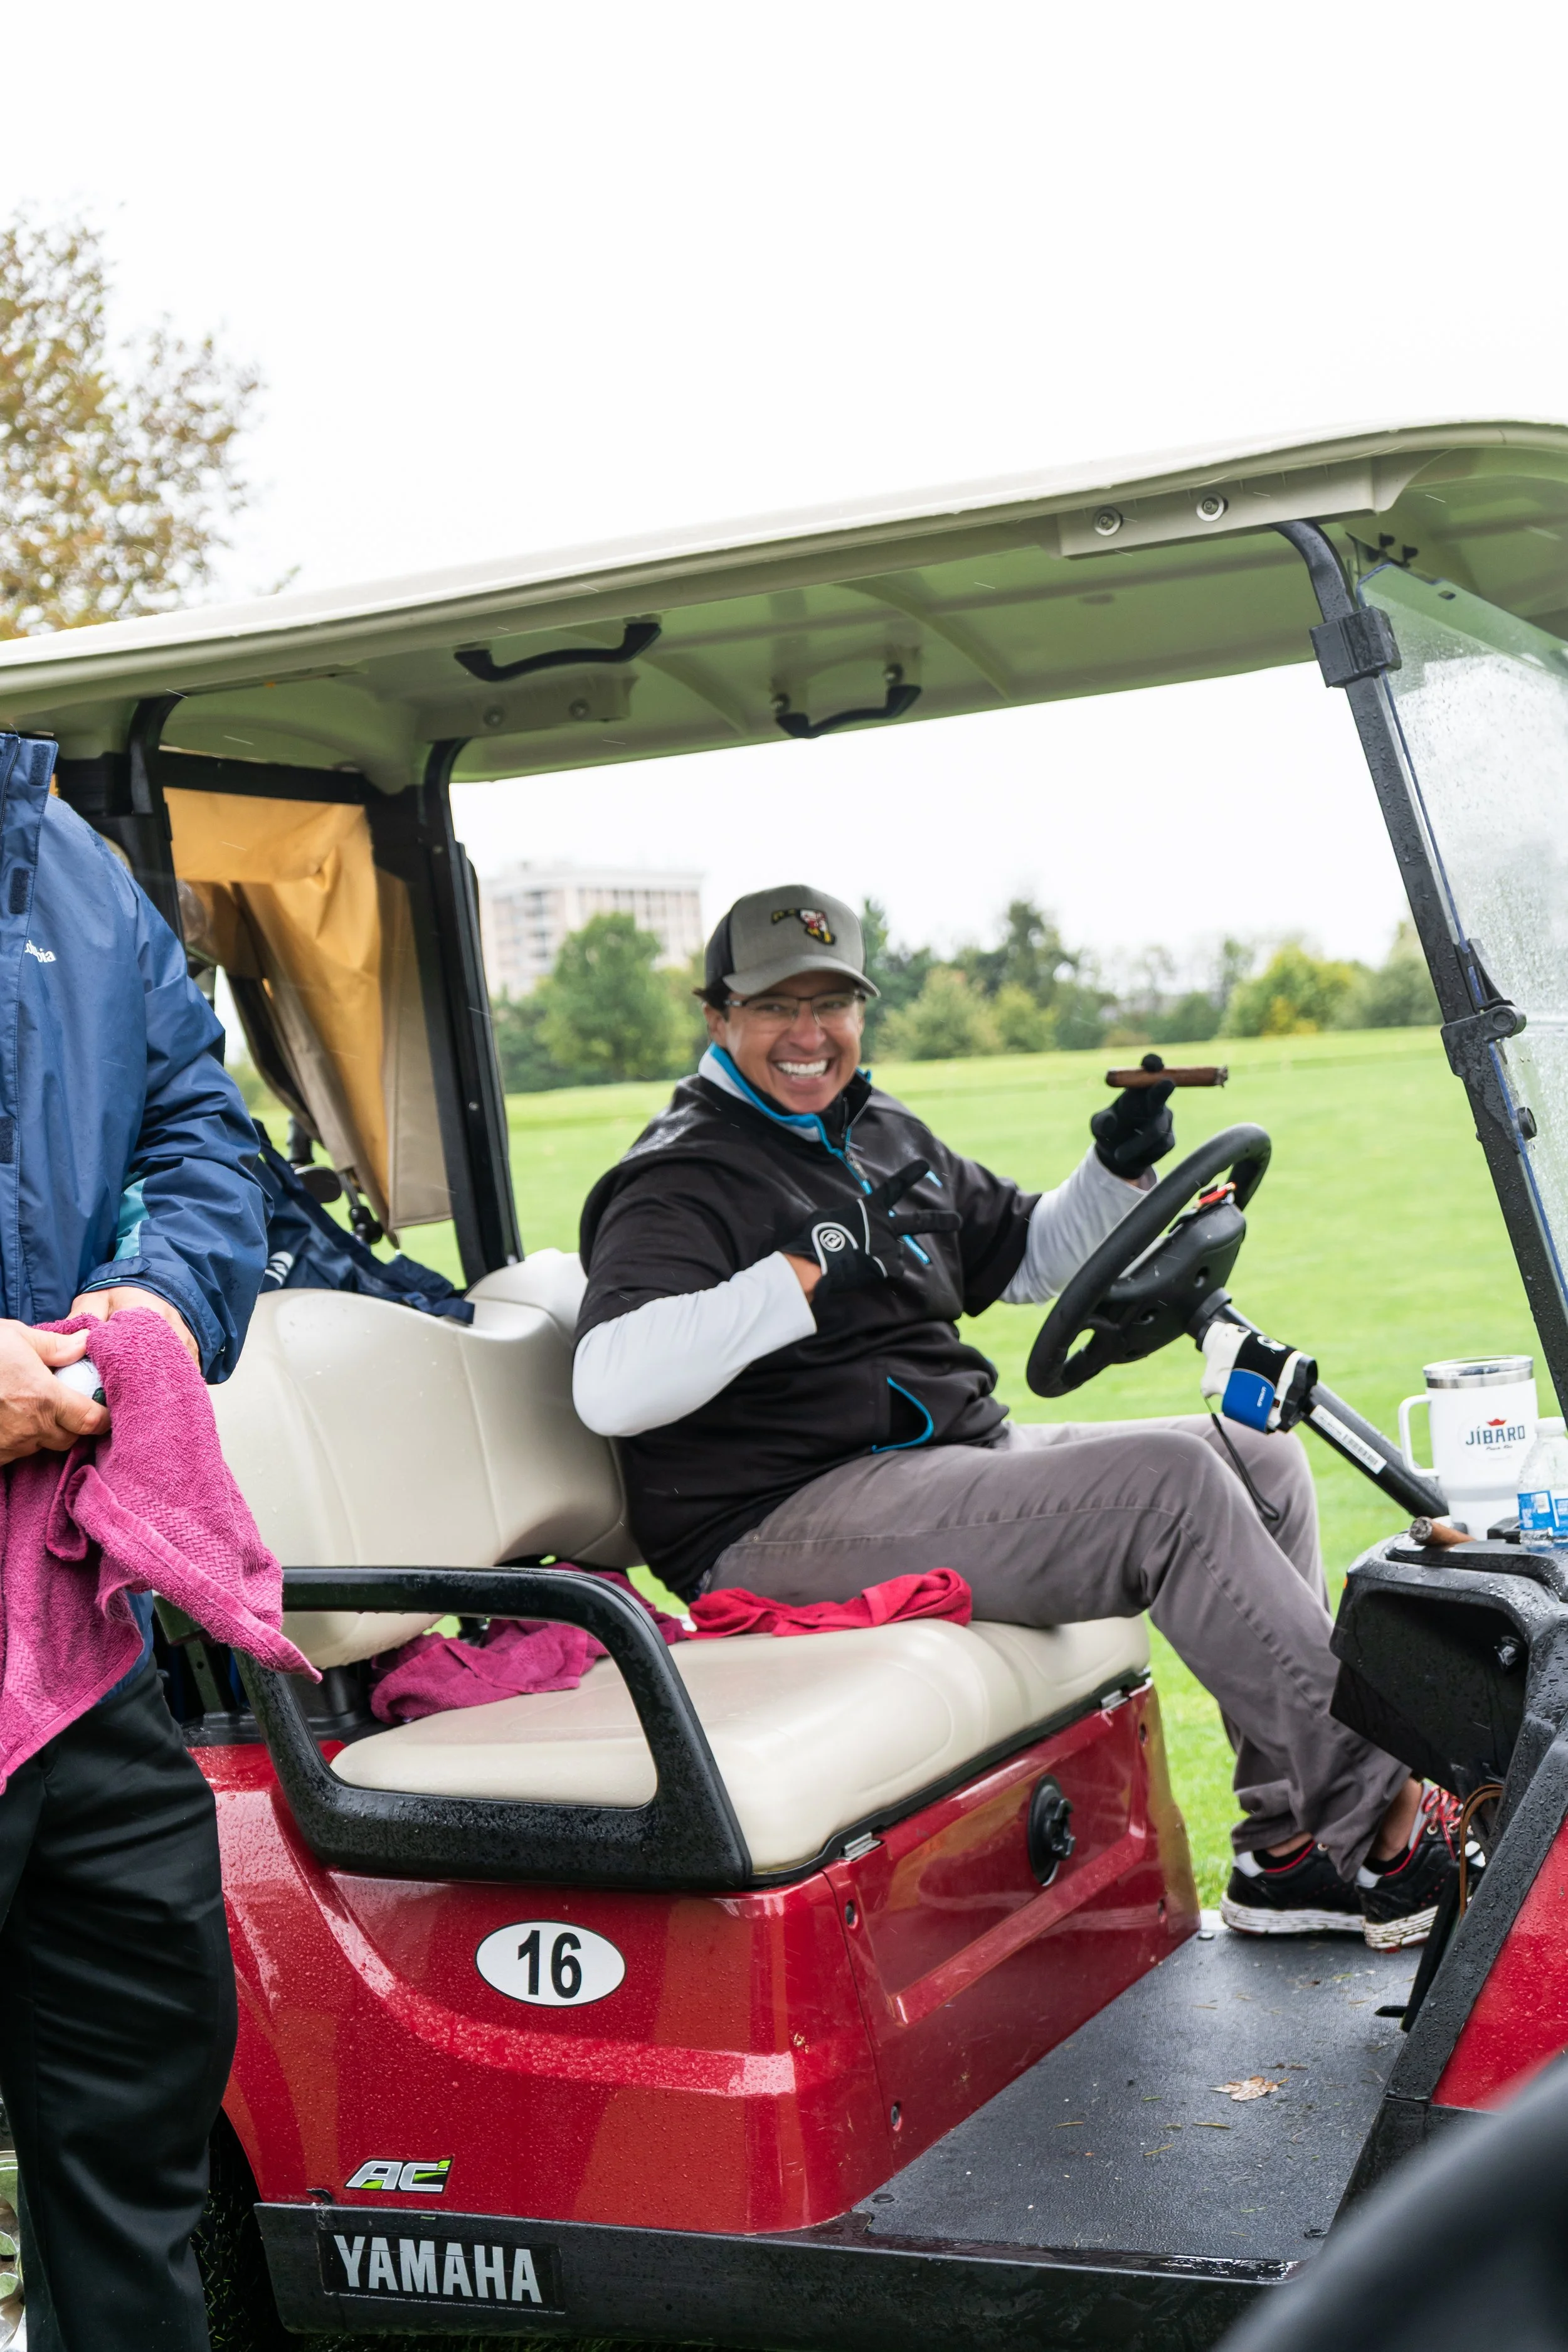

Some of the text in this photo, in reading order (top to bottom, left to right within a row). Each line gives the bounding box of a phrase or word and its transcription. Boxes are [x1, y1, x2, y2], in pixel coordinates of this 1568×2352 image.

[517, 1929, 583, 2000] 16
[345, 2159, 451, 2192] AC
[333, 2234, 544, 2304] YAMAHA
